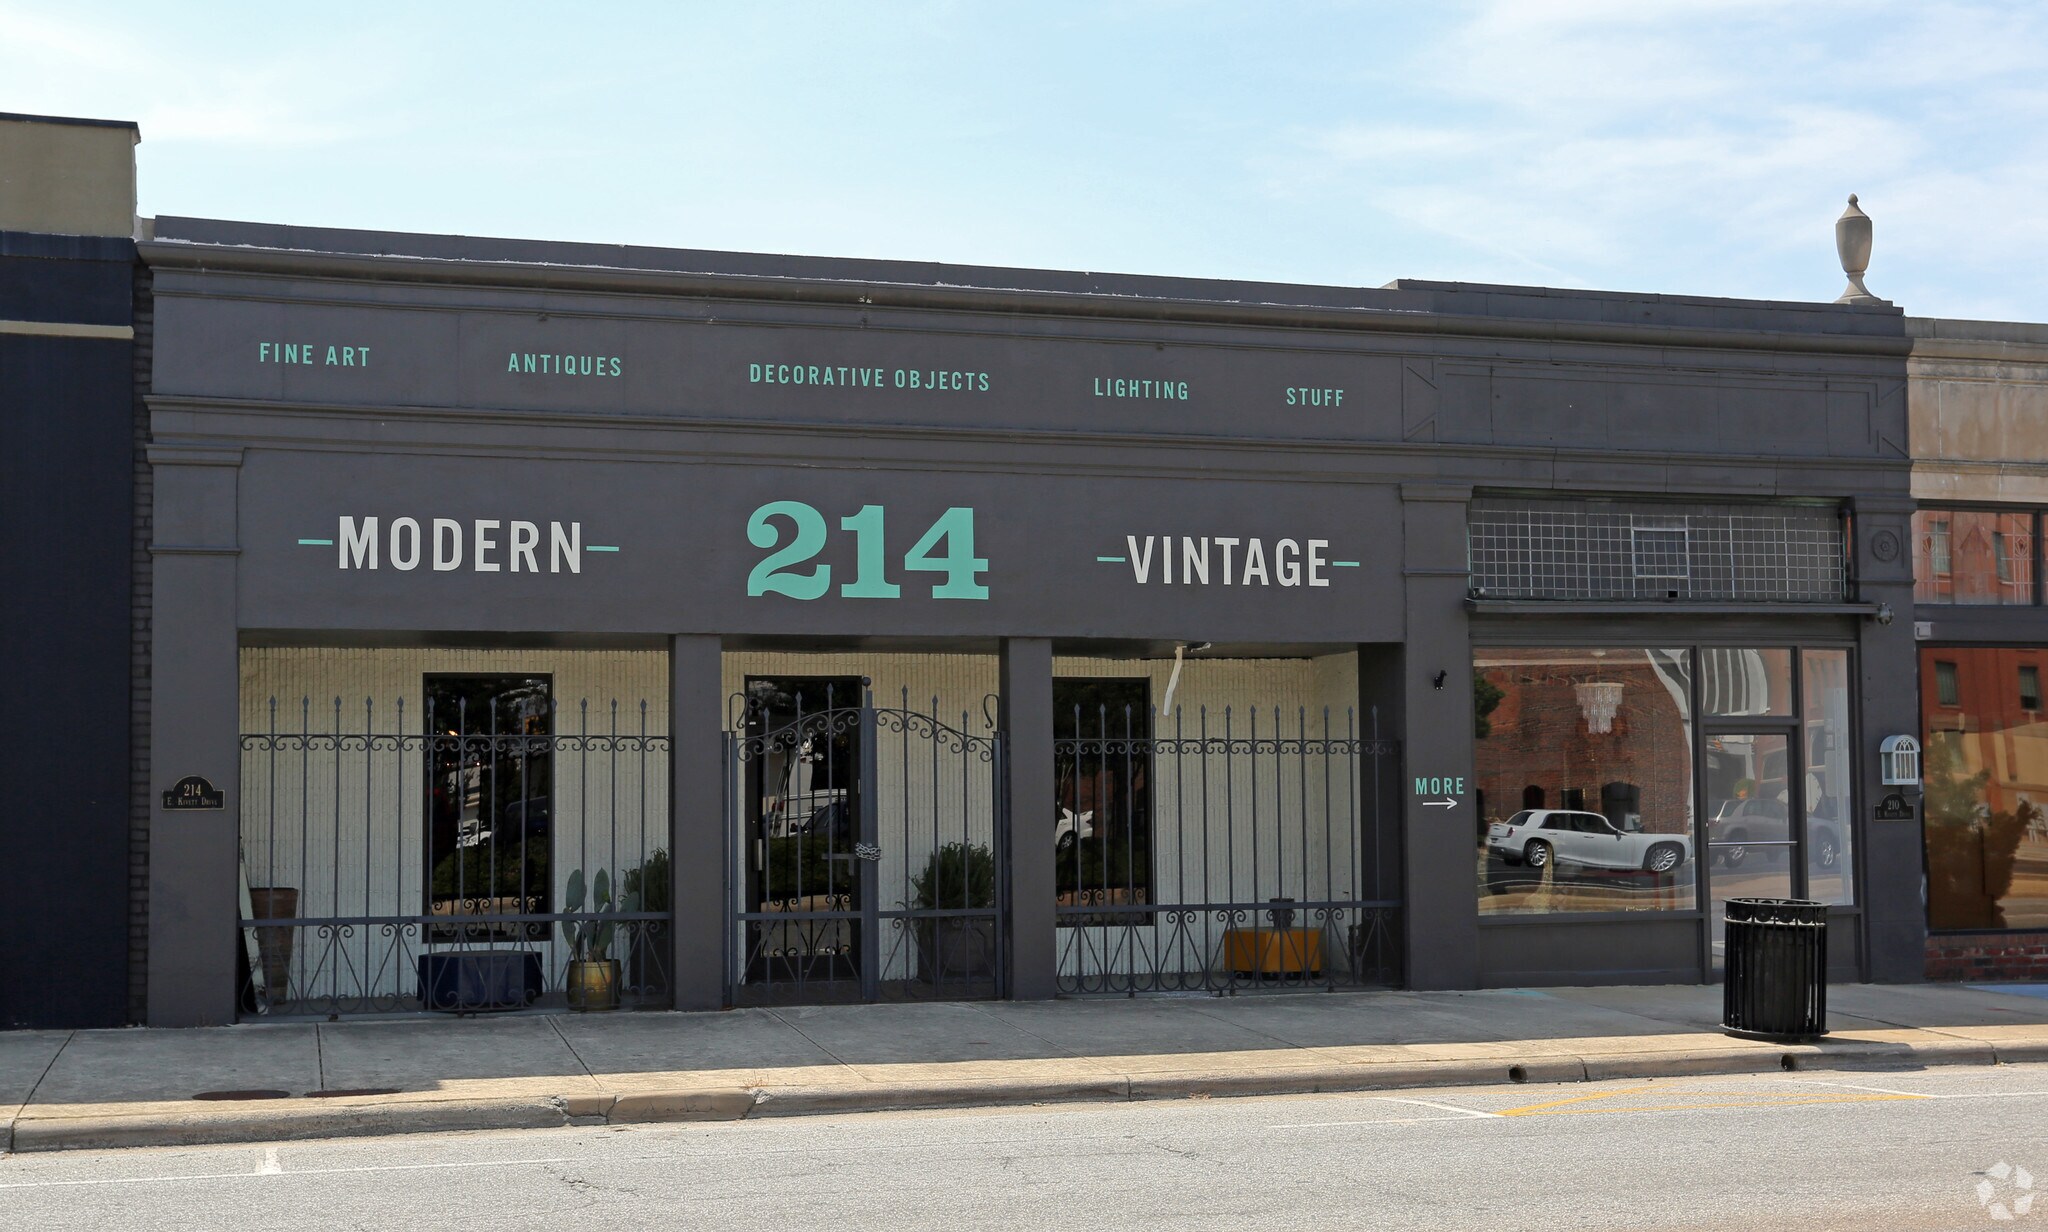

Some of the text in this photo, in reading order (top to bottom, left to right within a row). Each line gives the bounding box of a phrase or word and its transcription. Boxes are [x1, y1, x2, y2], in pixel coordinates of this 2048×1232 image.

[259, 342, 370, 367] FINE ART
[507, 352, 622, 377] ANTIQUES
[749, 363, 990, 392] DECORATIVE OBJECTS
[1094, 377, 1188, 401] LIGHTING
[1286, 387, 1344, 407] STUFF
[338, 515, 581, 574] MODERN
[746, 500, 990, 601] 214
[1126, 534, 1330, 587] VINTAGE
[184, 784, 202, 796] 214
[1415, 776, 1465, 796] MORE
[1887, 799, 1900, 810] 210
